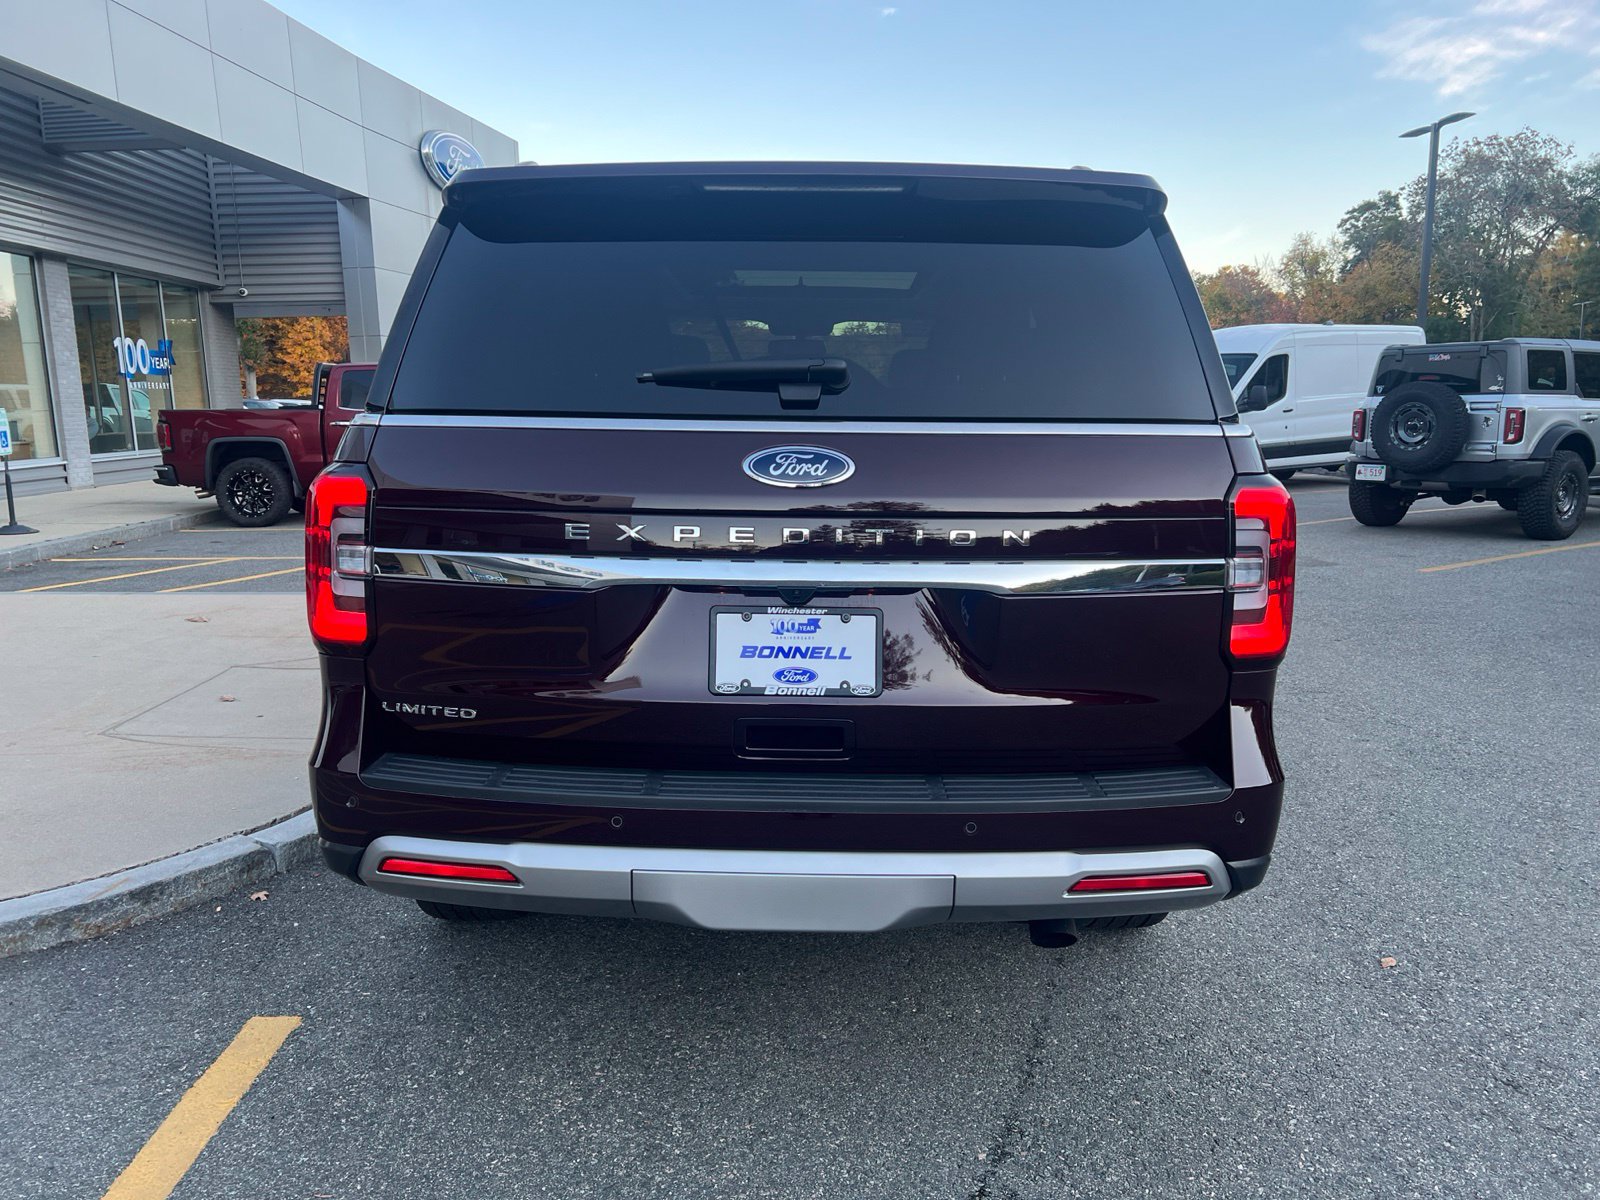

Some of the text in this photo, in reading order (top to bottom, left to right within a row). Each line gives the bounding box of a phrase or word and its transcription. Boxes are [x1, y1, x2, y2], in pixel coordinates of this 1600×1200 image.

[113, 337, 150, 374] 100
[769, 453, 829, 475] Ford
[1369, 468, 1383, 477] 519
[564, 523, 1031, 547] EXPEDITION
[767, 606, 828, 615] Winchester
[770, 618, 799, 634] 100
[739, 645, 852, 660] BONNELL
[780, 669, 809, 682] Ford
[764, 685, 827, 696] Bonnell
[381, 701, 477, 719] LIMITED
